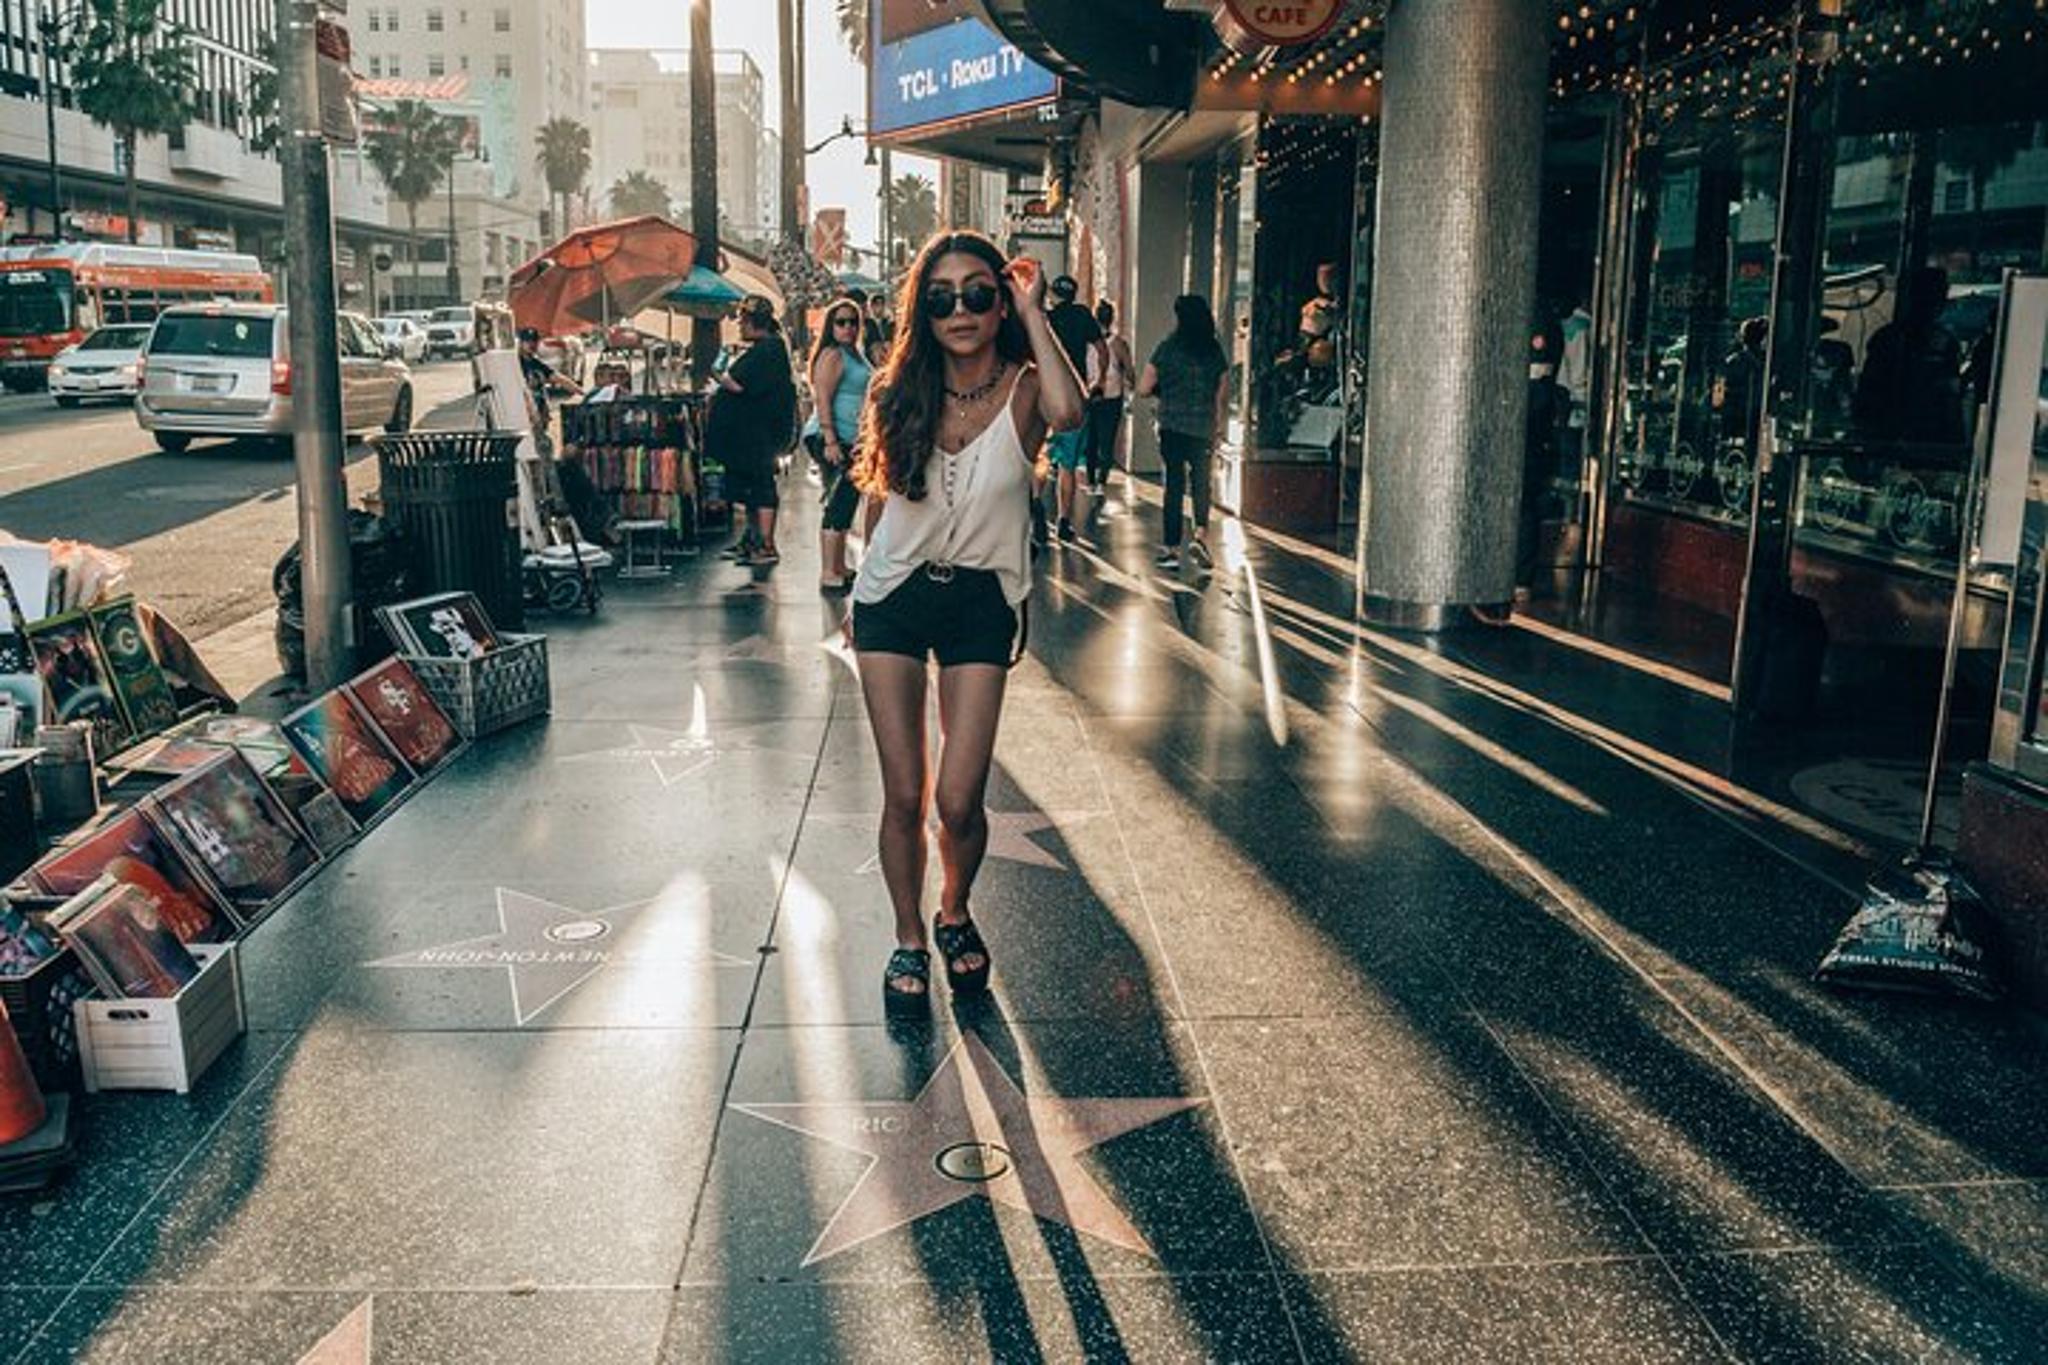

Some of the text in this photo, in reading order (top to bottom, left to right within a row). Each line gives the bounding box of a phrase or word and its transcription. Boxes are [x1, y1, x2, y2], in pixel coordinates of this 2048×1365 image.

[1255, 6, 1307, 26] CAFE
[899, 68, 939, 102] TCL
[999, 44, 1026, 77] TV
[1037, 103, 1060, 123] TCL
[418, 951, 611, 963] NEWTON-JOHN
